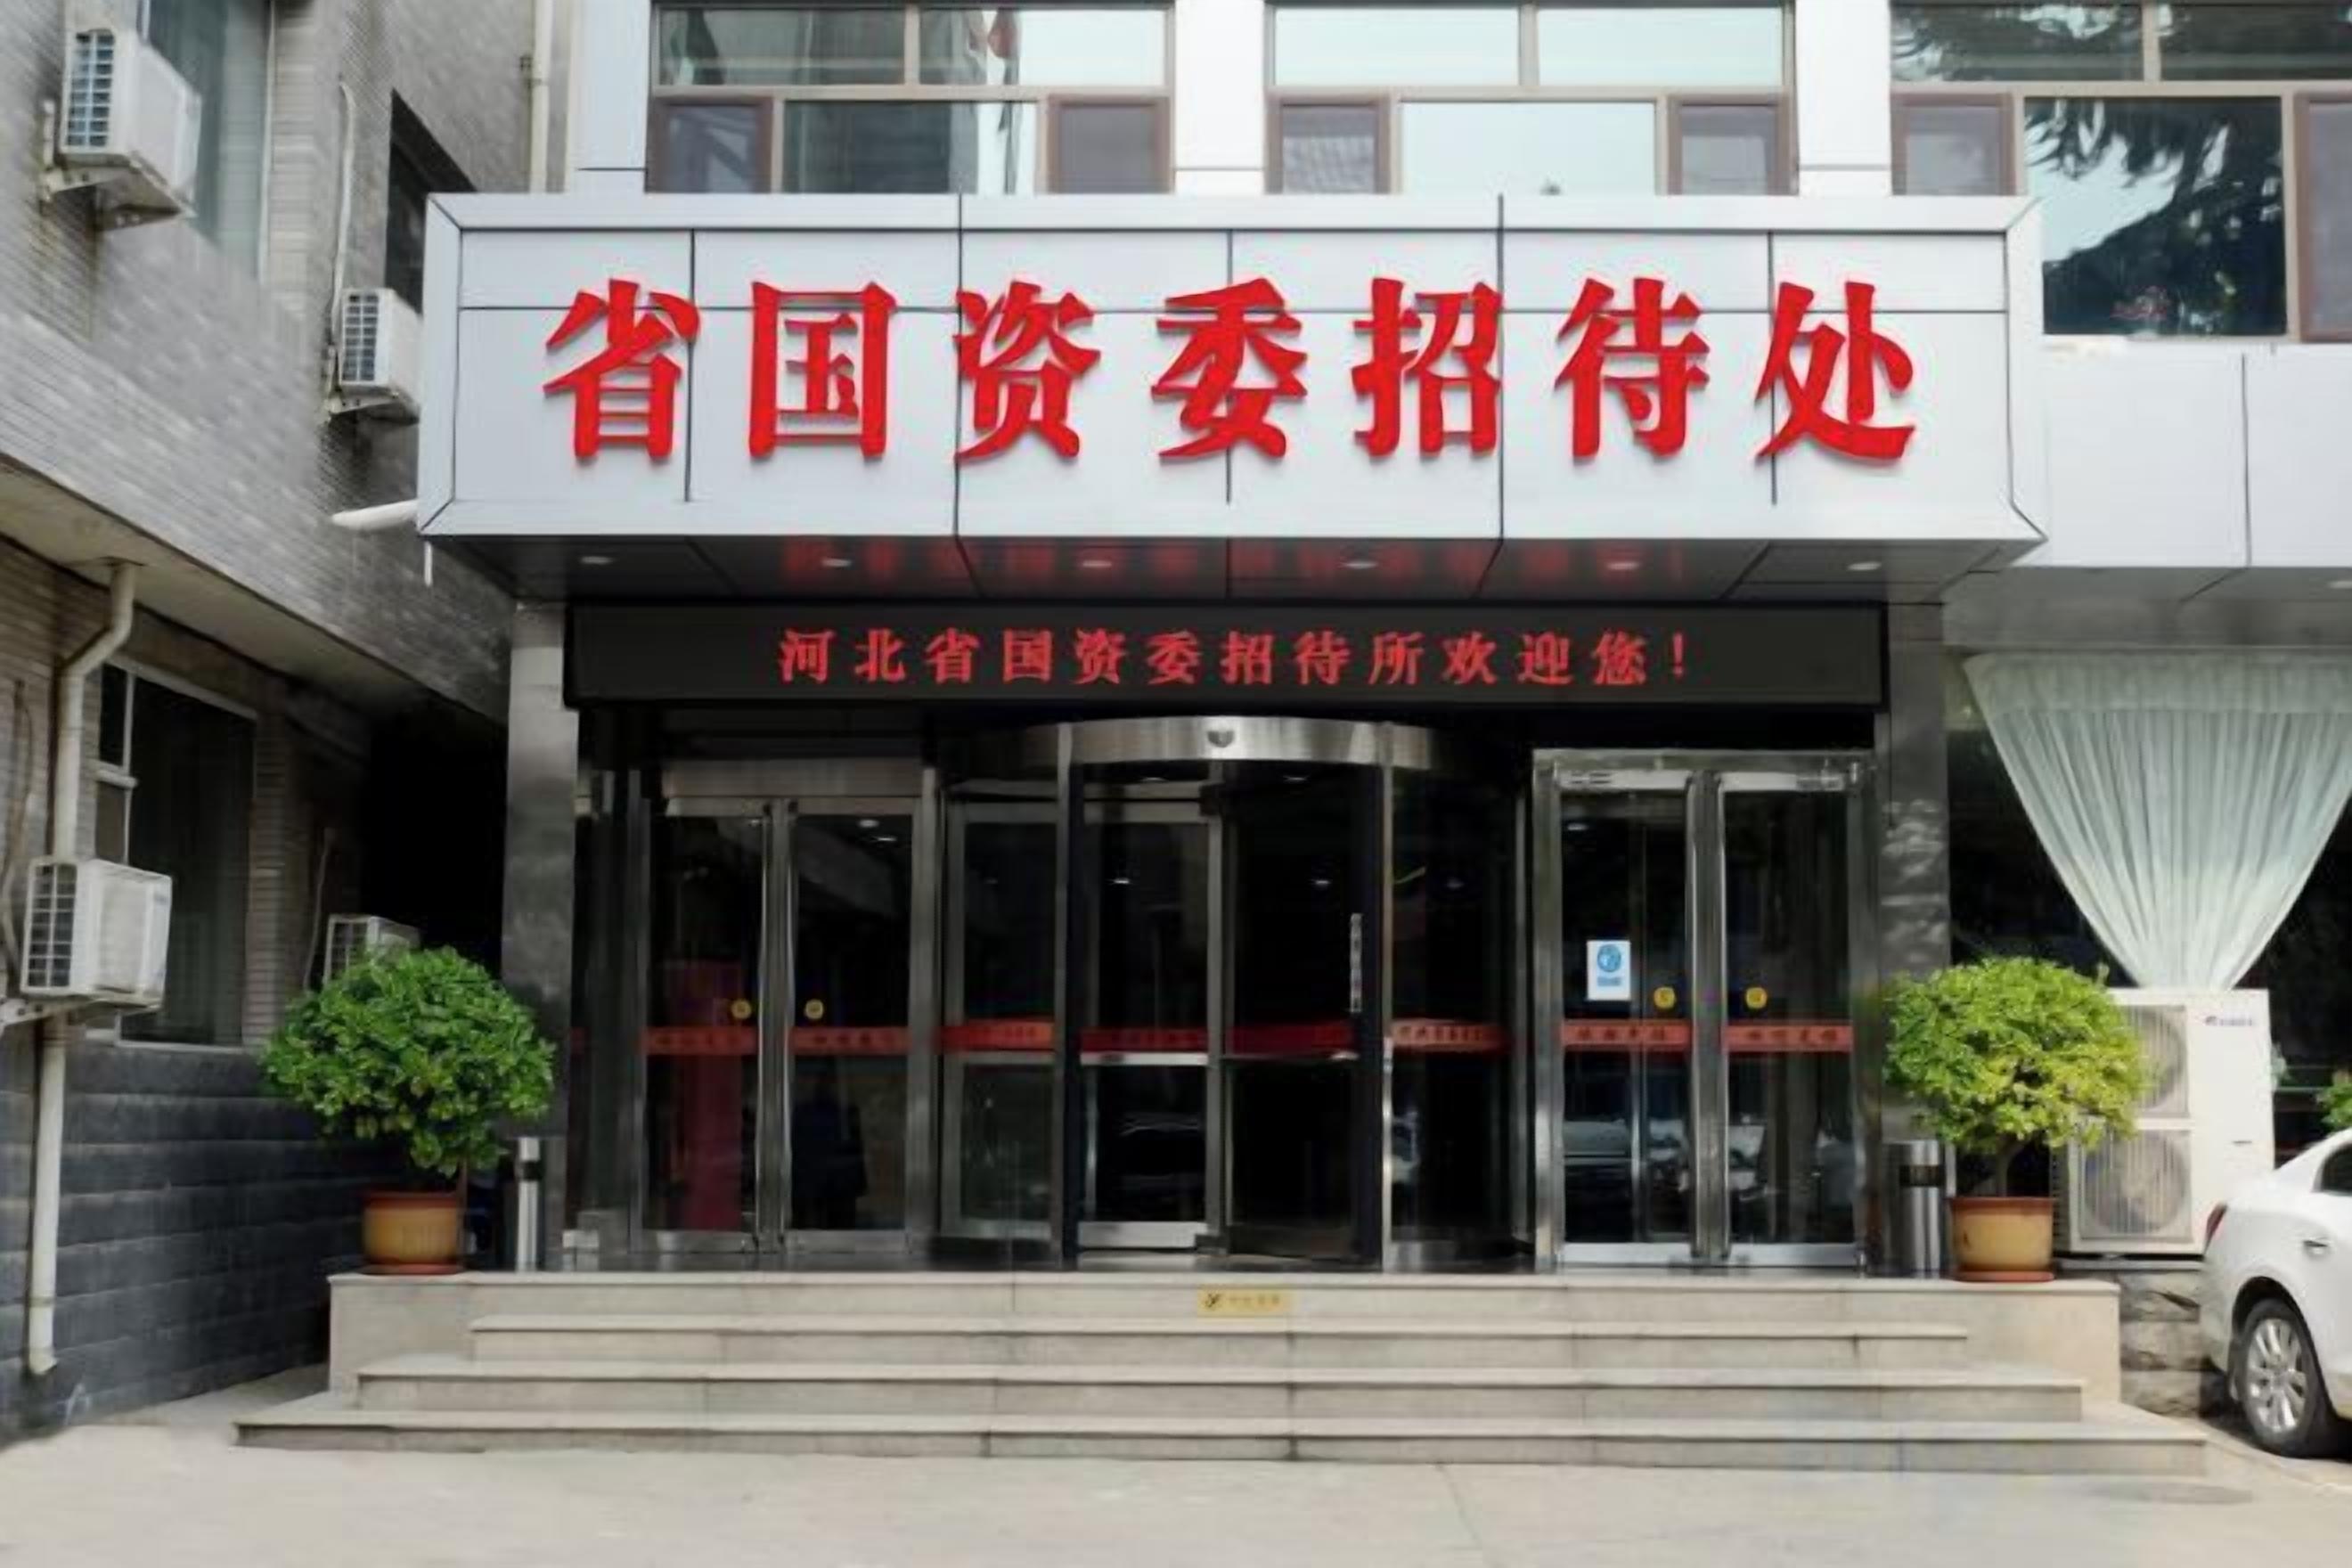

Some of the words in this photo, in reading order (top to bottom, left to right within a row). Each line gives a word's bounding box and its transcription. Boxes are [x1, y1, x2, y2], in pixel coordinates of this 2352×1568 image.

[545, 277, 1915, 461] 省国资委招待处
[780, 628, 1689, 685] 河北省国资委招待所欢迎您！
